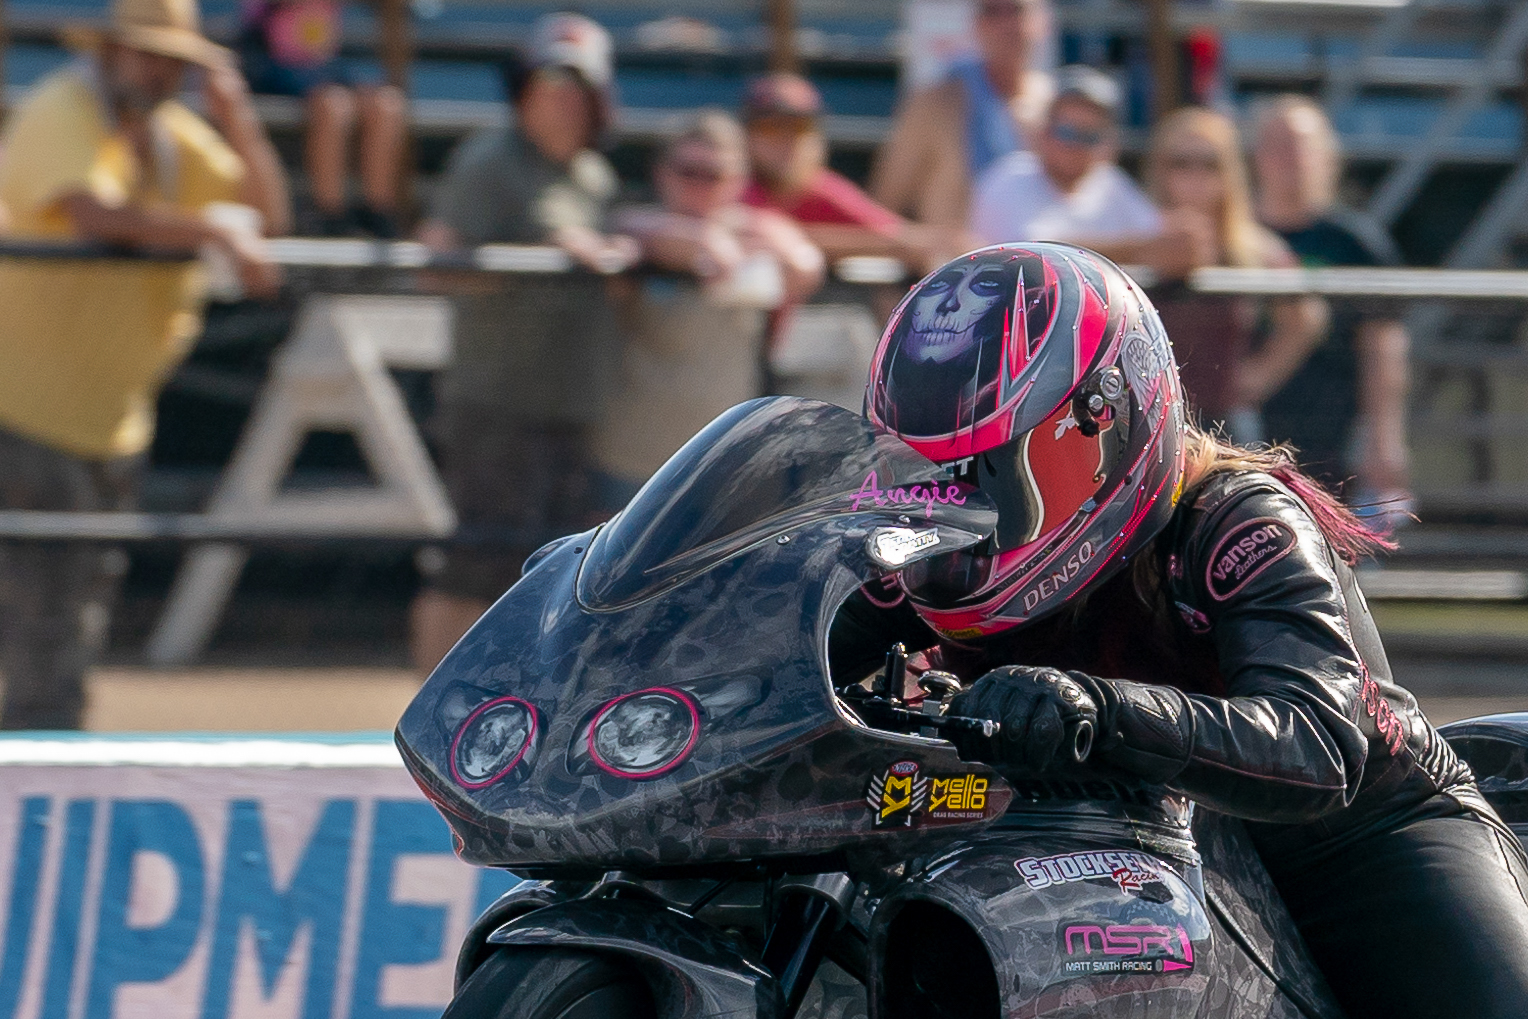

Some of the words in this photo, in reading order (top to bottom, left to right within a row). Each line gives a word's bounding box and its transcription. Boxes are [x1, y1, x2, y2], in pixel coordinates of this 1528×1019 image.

[849, 470, 966, 518] Angie
[1023, 541, 1093, 612] DENSO
[1213, 524, 1283, 581] vanson
[1065, 962, 1091, 971] MATT
[1092, 962, 1121, 971] SMITH
[1122, 961, 1152, 971] RACING
